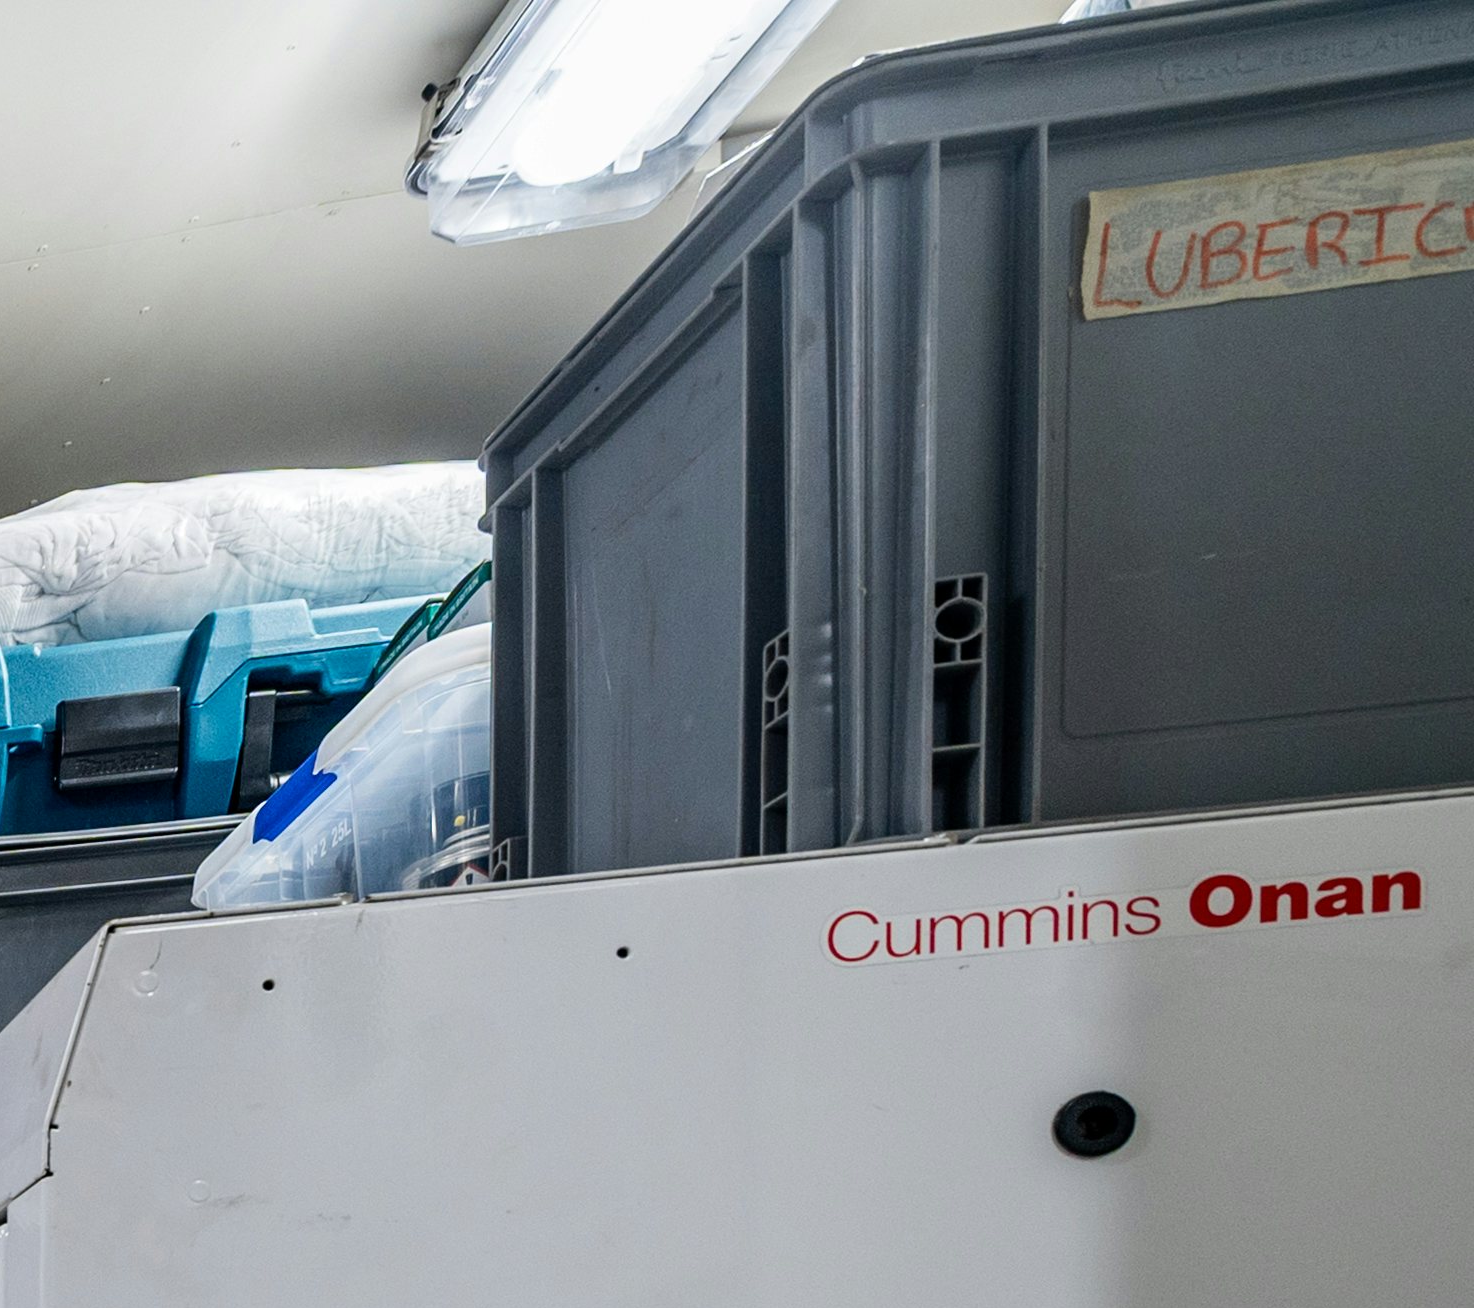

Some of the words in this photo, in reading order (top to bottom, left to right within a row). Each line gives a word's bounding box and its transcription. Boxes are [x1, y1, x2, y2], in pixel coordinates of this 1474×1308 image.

[331, 818, 352, 847] 25L
[827, 891, 1162, 962] Cummins
[1188, 871, 1422, 928] Onan
